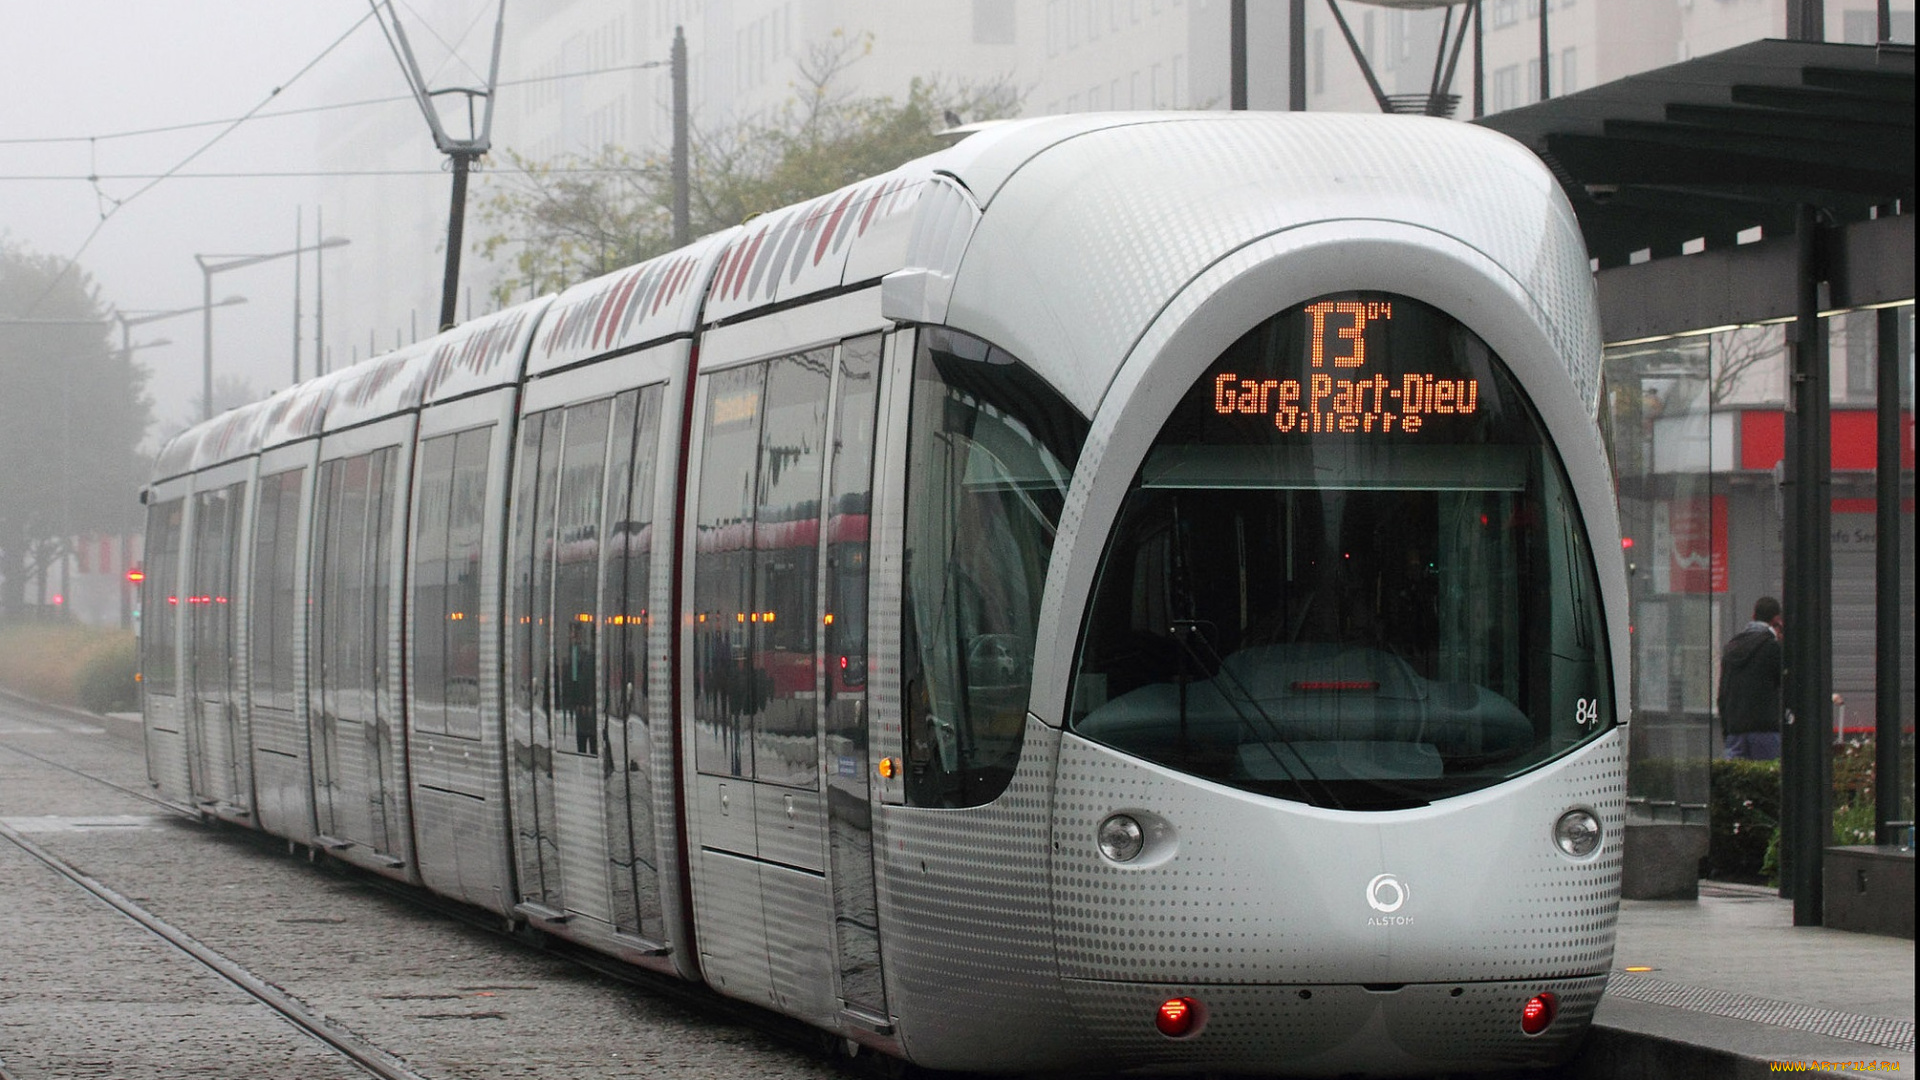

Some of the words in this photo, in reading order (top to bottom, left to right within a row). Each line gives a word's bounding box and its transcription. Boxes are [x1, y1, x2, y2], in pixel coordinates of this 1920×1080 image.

[1215, 373, 1300, 414] Gare
[1310, 373, 1478, 414] Part-Dieu
[1575, 697, 1598, 725] 84
[1367, 916, 1414, 926] ALSTOM
